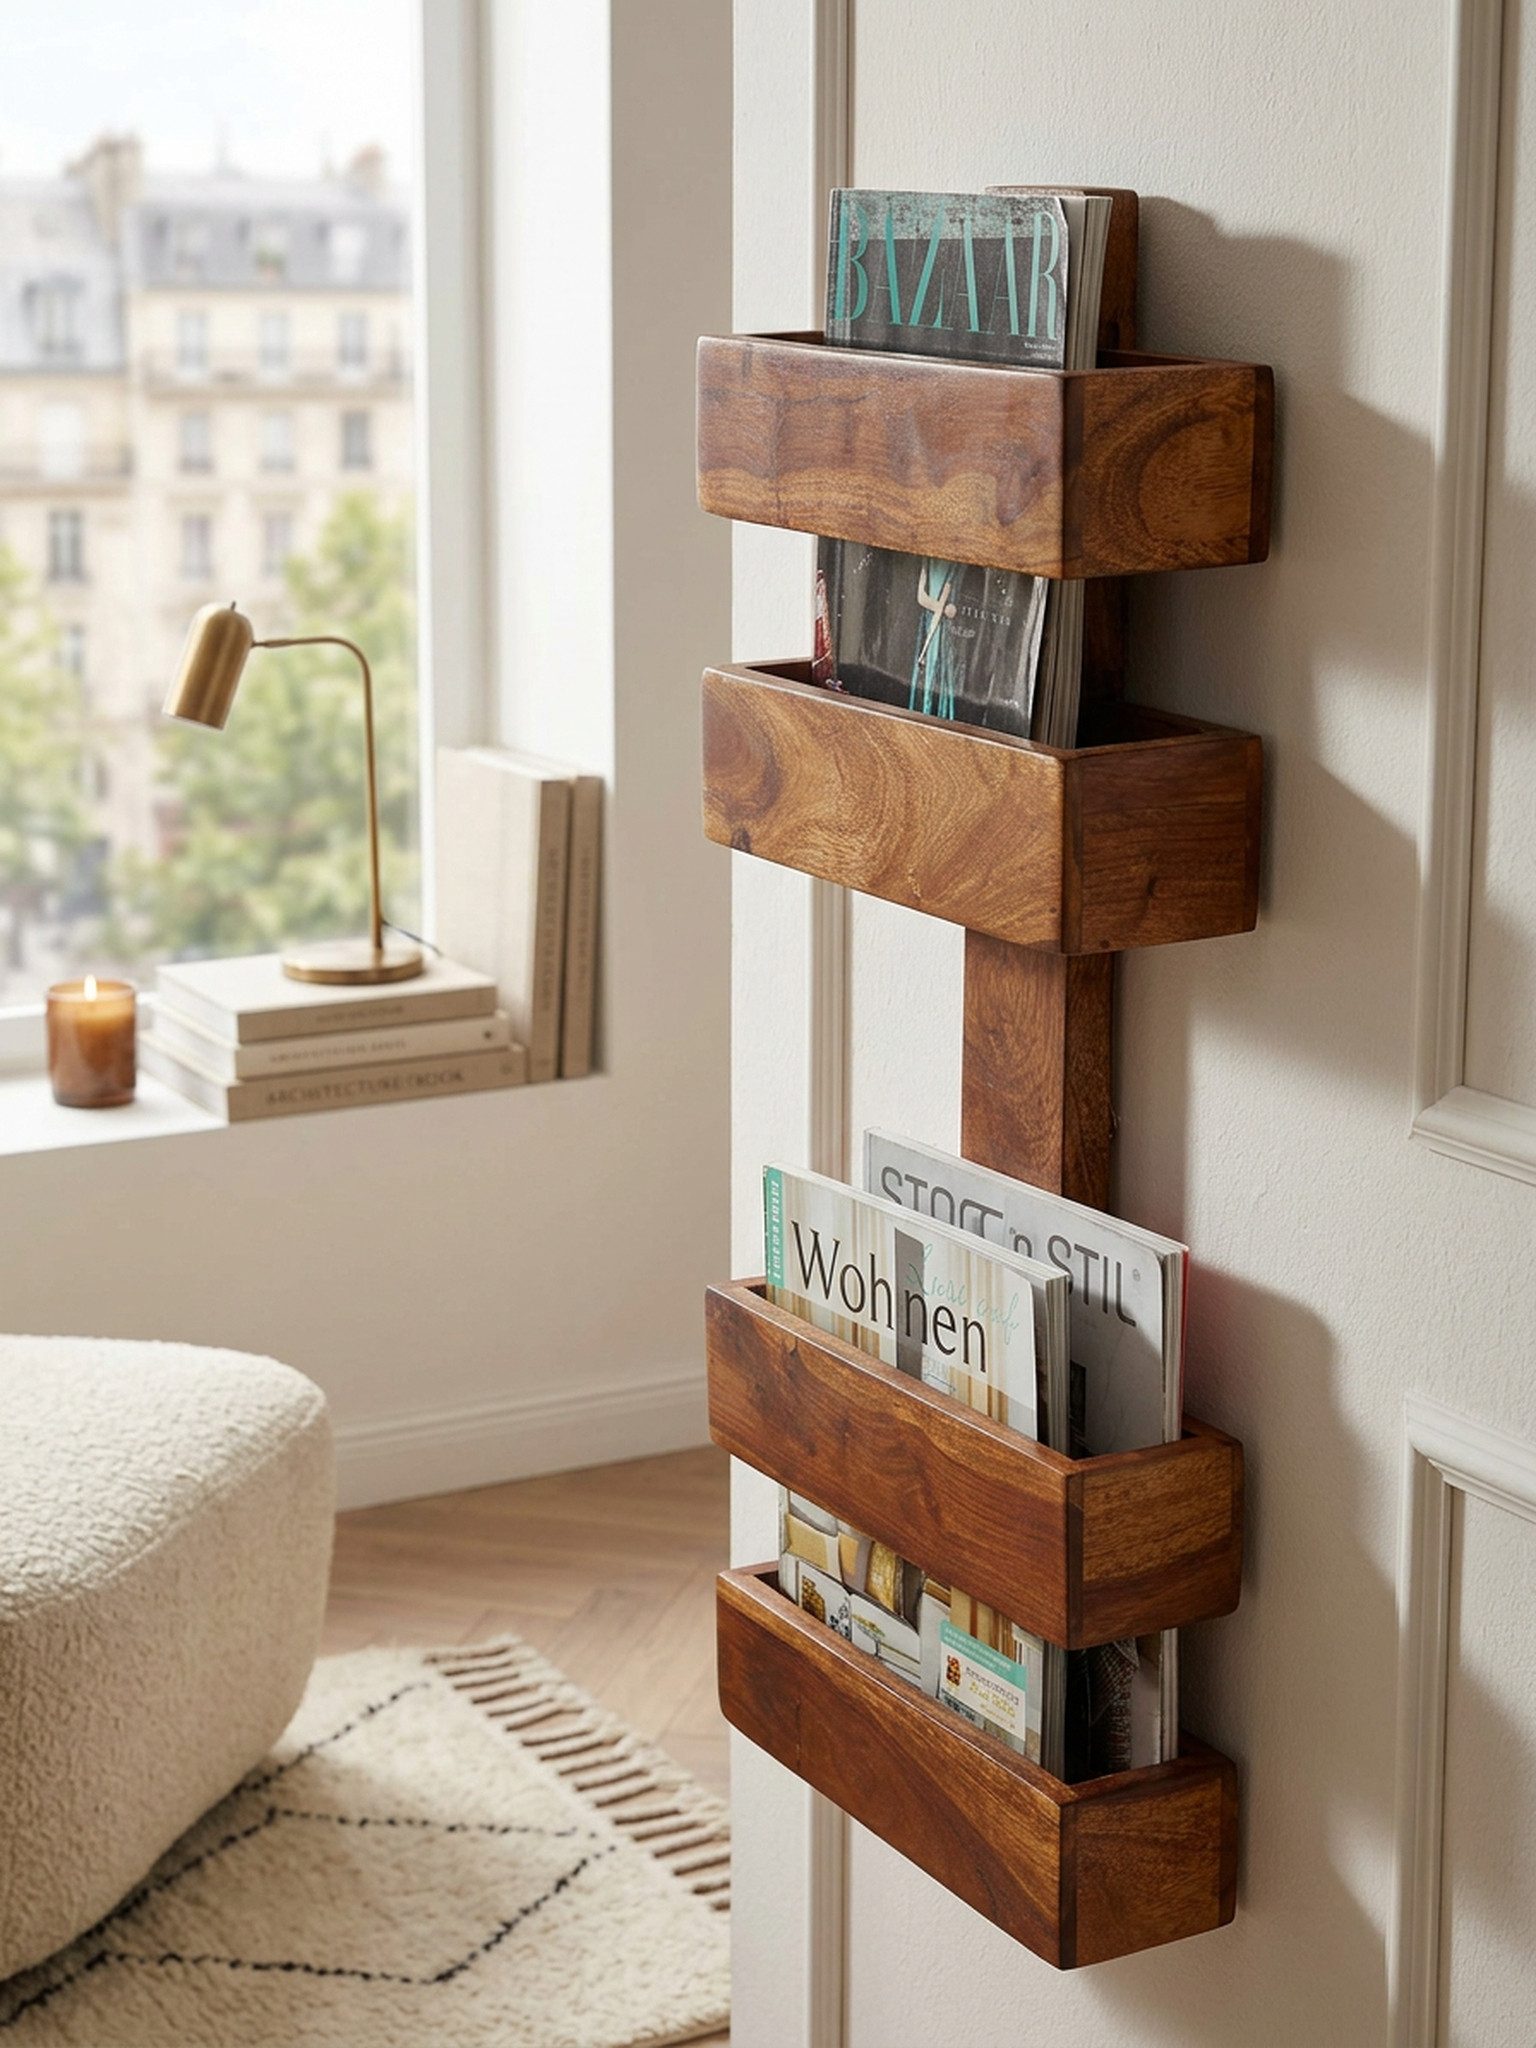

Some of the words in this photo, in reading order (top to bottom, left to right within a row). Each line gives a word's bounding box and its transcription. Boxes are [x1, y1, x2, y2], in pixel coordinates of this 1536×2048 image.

[834, 192, 1058, 340] BAZAAR
[791, 1220, 986, 1373] Wohnen
[1048, 1235, 1136, 1327] STIL
